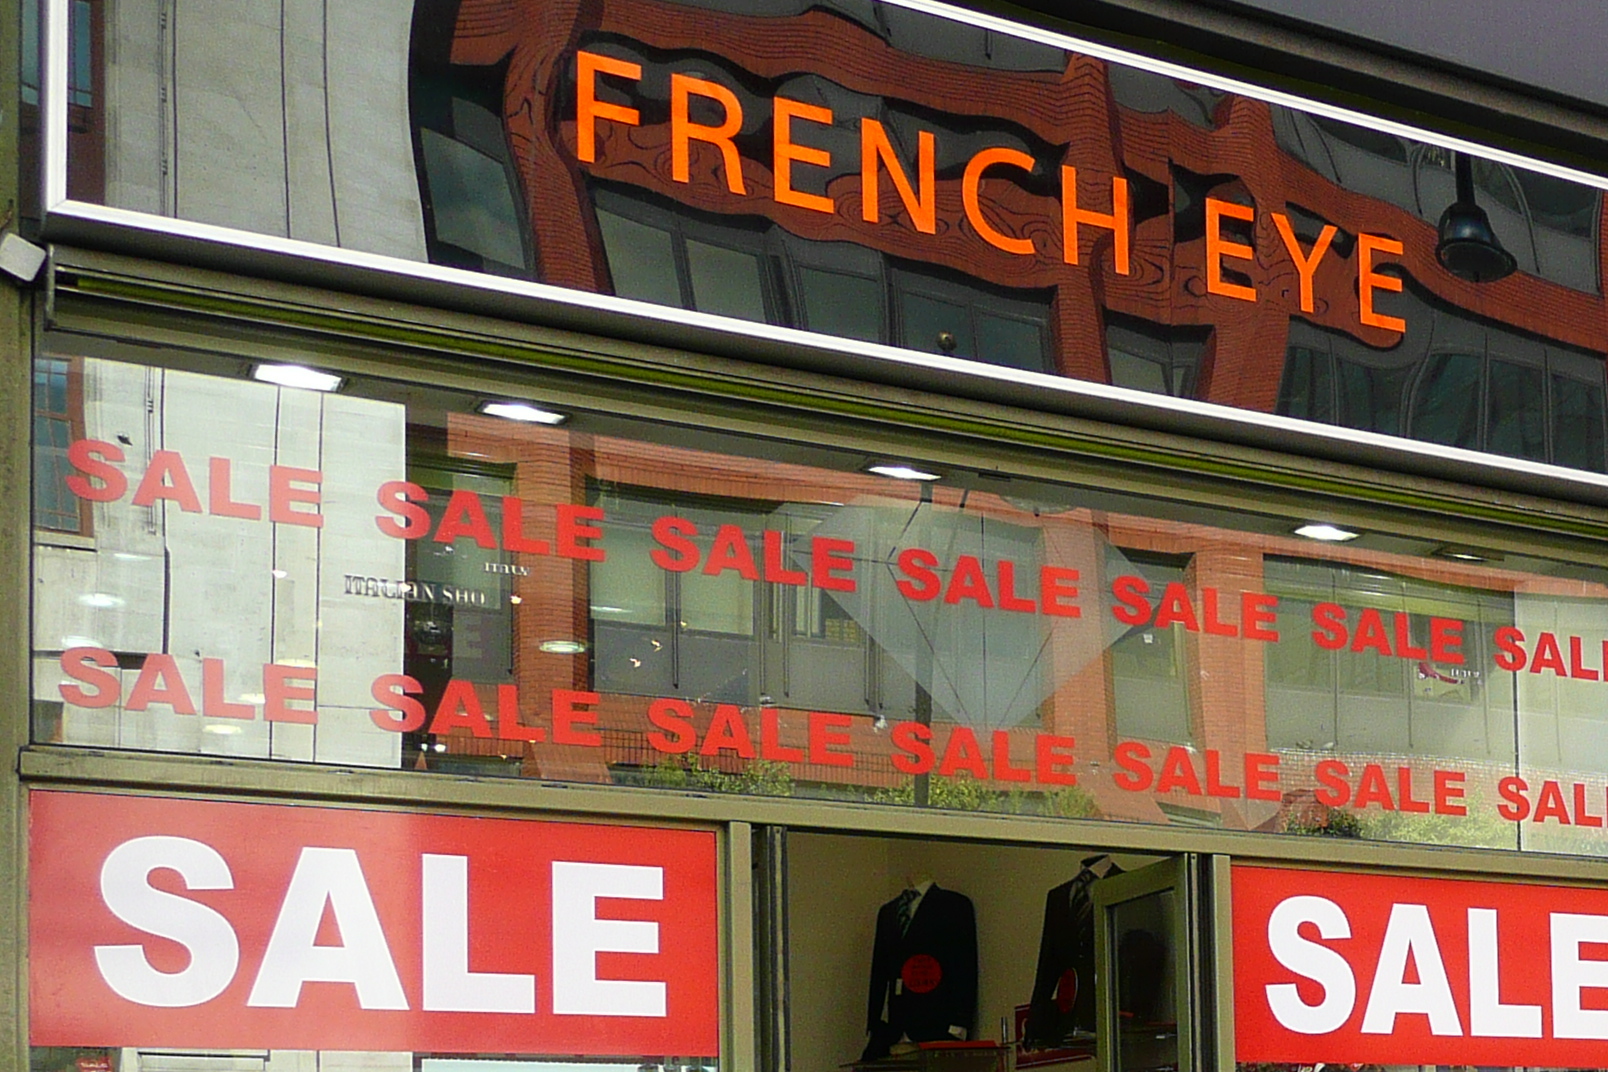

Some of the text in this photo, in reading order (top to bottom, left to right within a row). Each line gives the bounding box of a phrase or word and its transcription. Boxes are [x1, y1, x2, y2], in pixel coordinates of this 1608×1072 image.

[576, 50, 1406, 334] FRENCH EYE
[66, 439, 324, 528] SALE
[375, 480, 605, 562] SALE
[651, 516, 857, 592] SALE
[896, 548, 1081, 619] SALE
[1112, 575, 1279, 643] SALE
[1312, 602, 1464, 665] SALE
[59, 646, 318, 725] SALE
[370, 673, 604, 748] SALE
[645, 697, 855, 768] SALE
[890, 721, 1078, 786] SALE
[1112, 741, 1283, 802] SALE
[1313, 759, 1467, 816] SALE
[93, 836, 668, 1018] SALE
